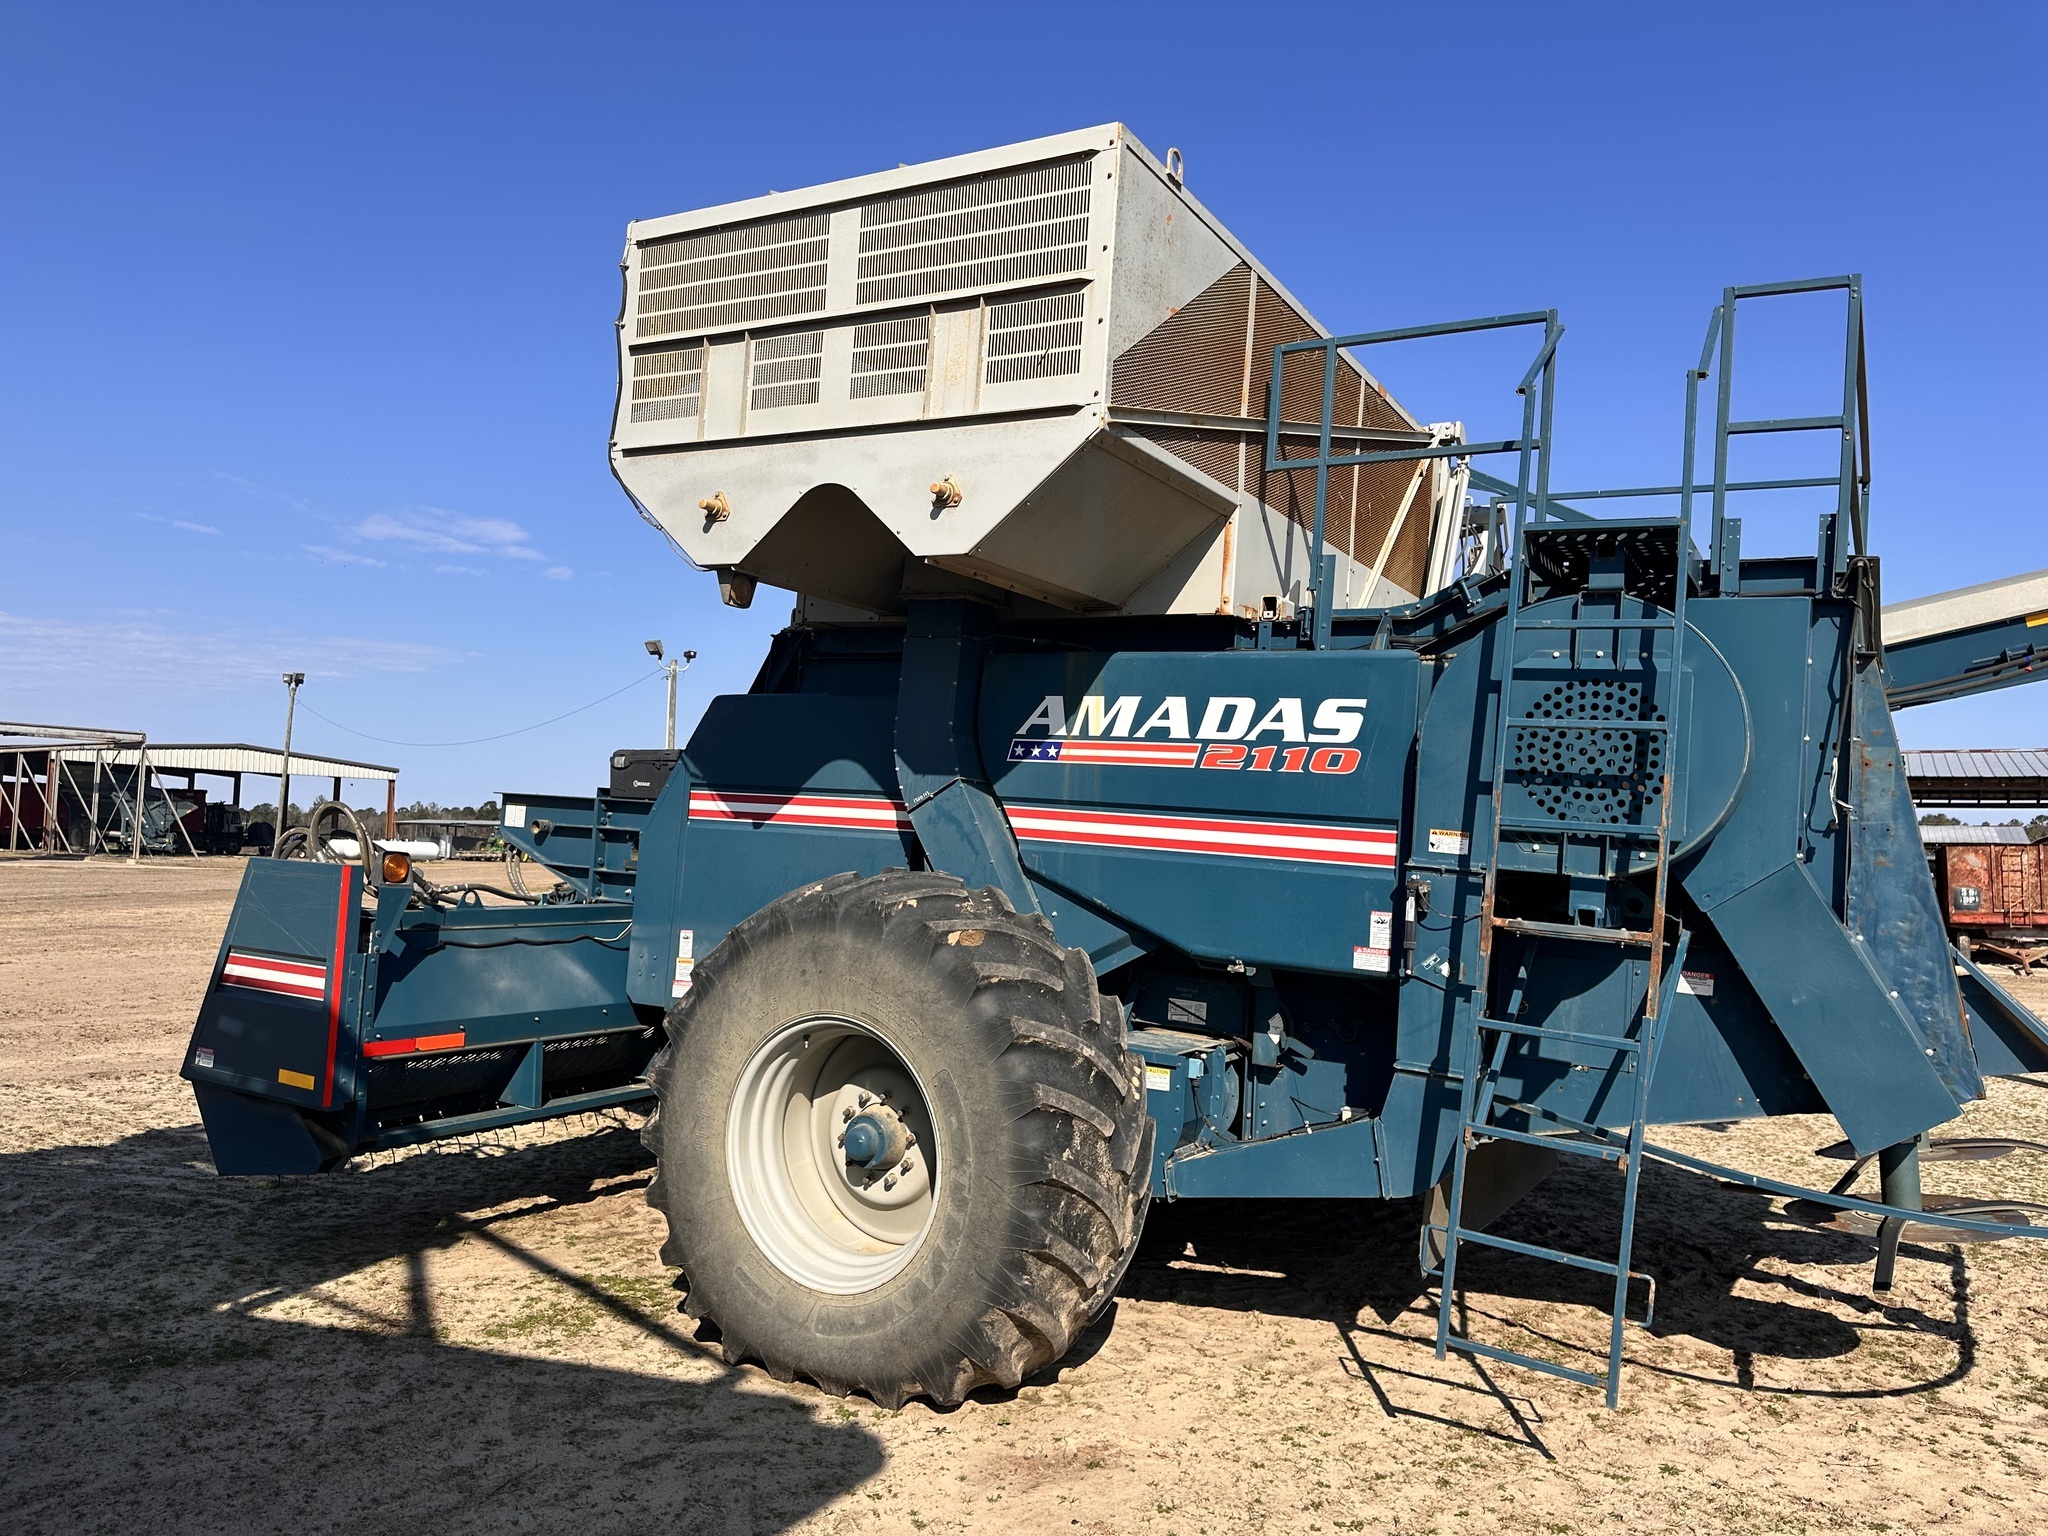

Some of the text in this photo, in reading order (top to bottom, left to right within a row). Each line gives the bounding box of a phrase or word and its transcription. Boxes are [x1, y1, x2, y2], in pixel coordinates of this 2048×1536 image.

[1015, 695, 1368, 744] AMADAS
[1200, 743, 1362, 775] 2110
[1438, 830, 1469, 839] WARNING
[1362, 947, 1388, 956] DANGER
[1682, 970, 1710, 979] DANGER
[1146, 1067, 1168, 1075] CAUTION
